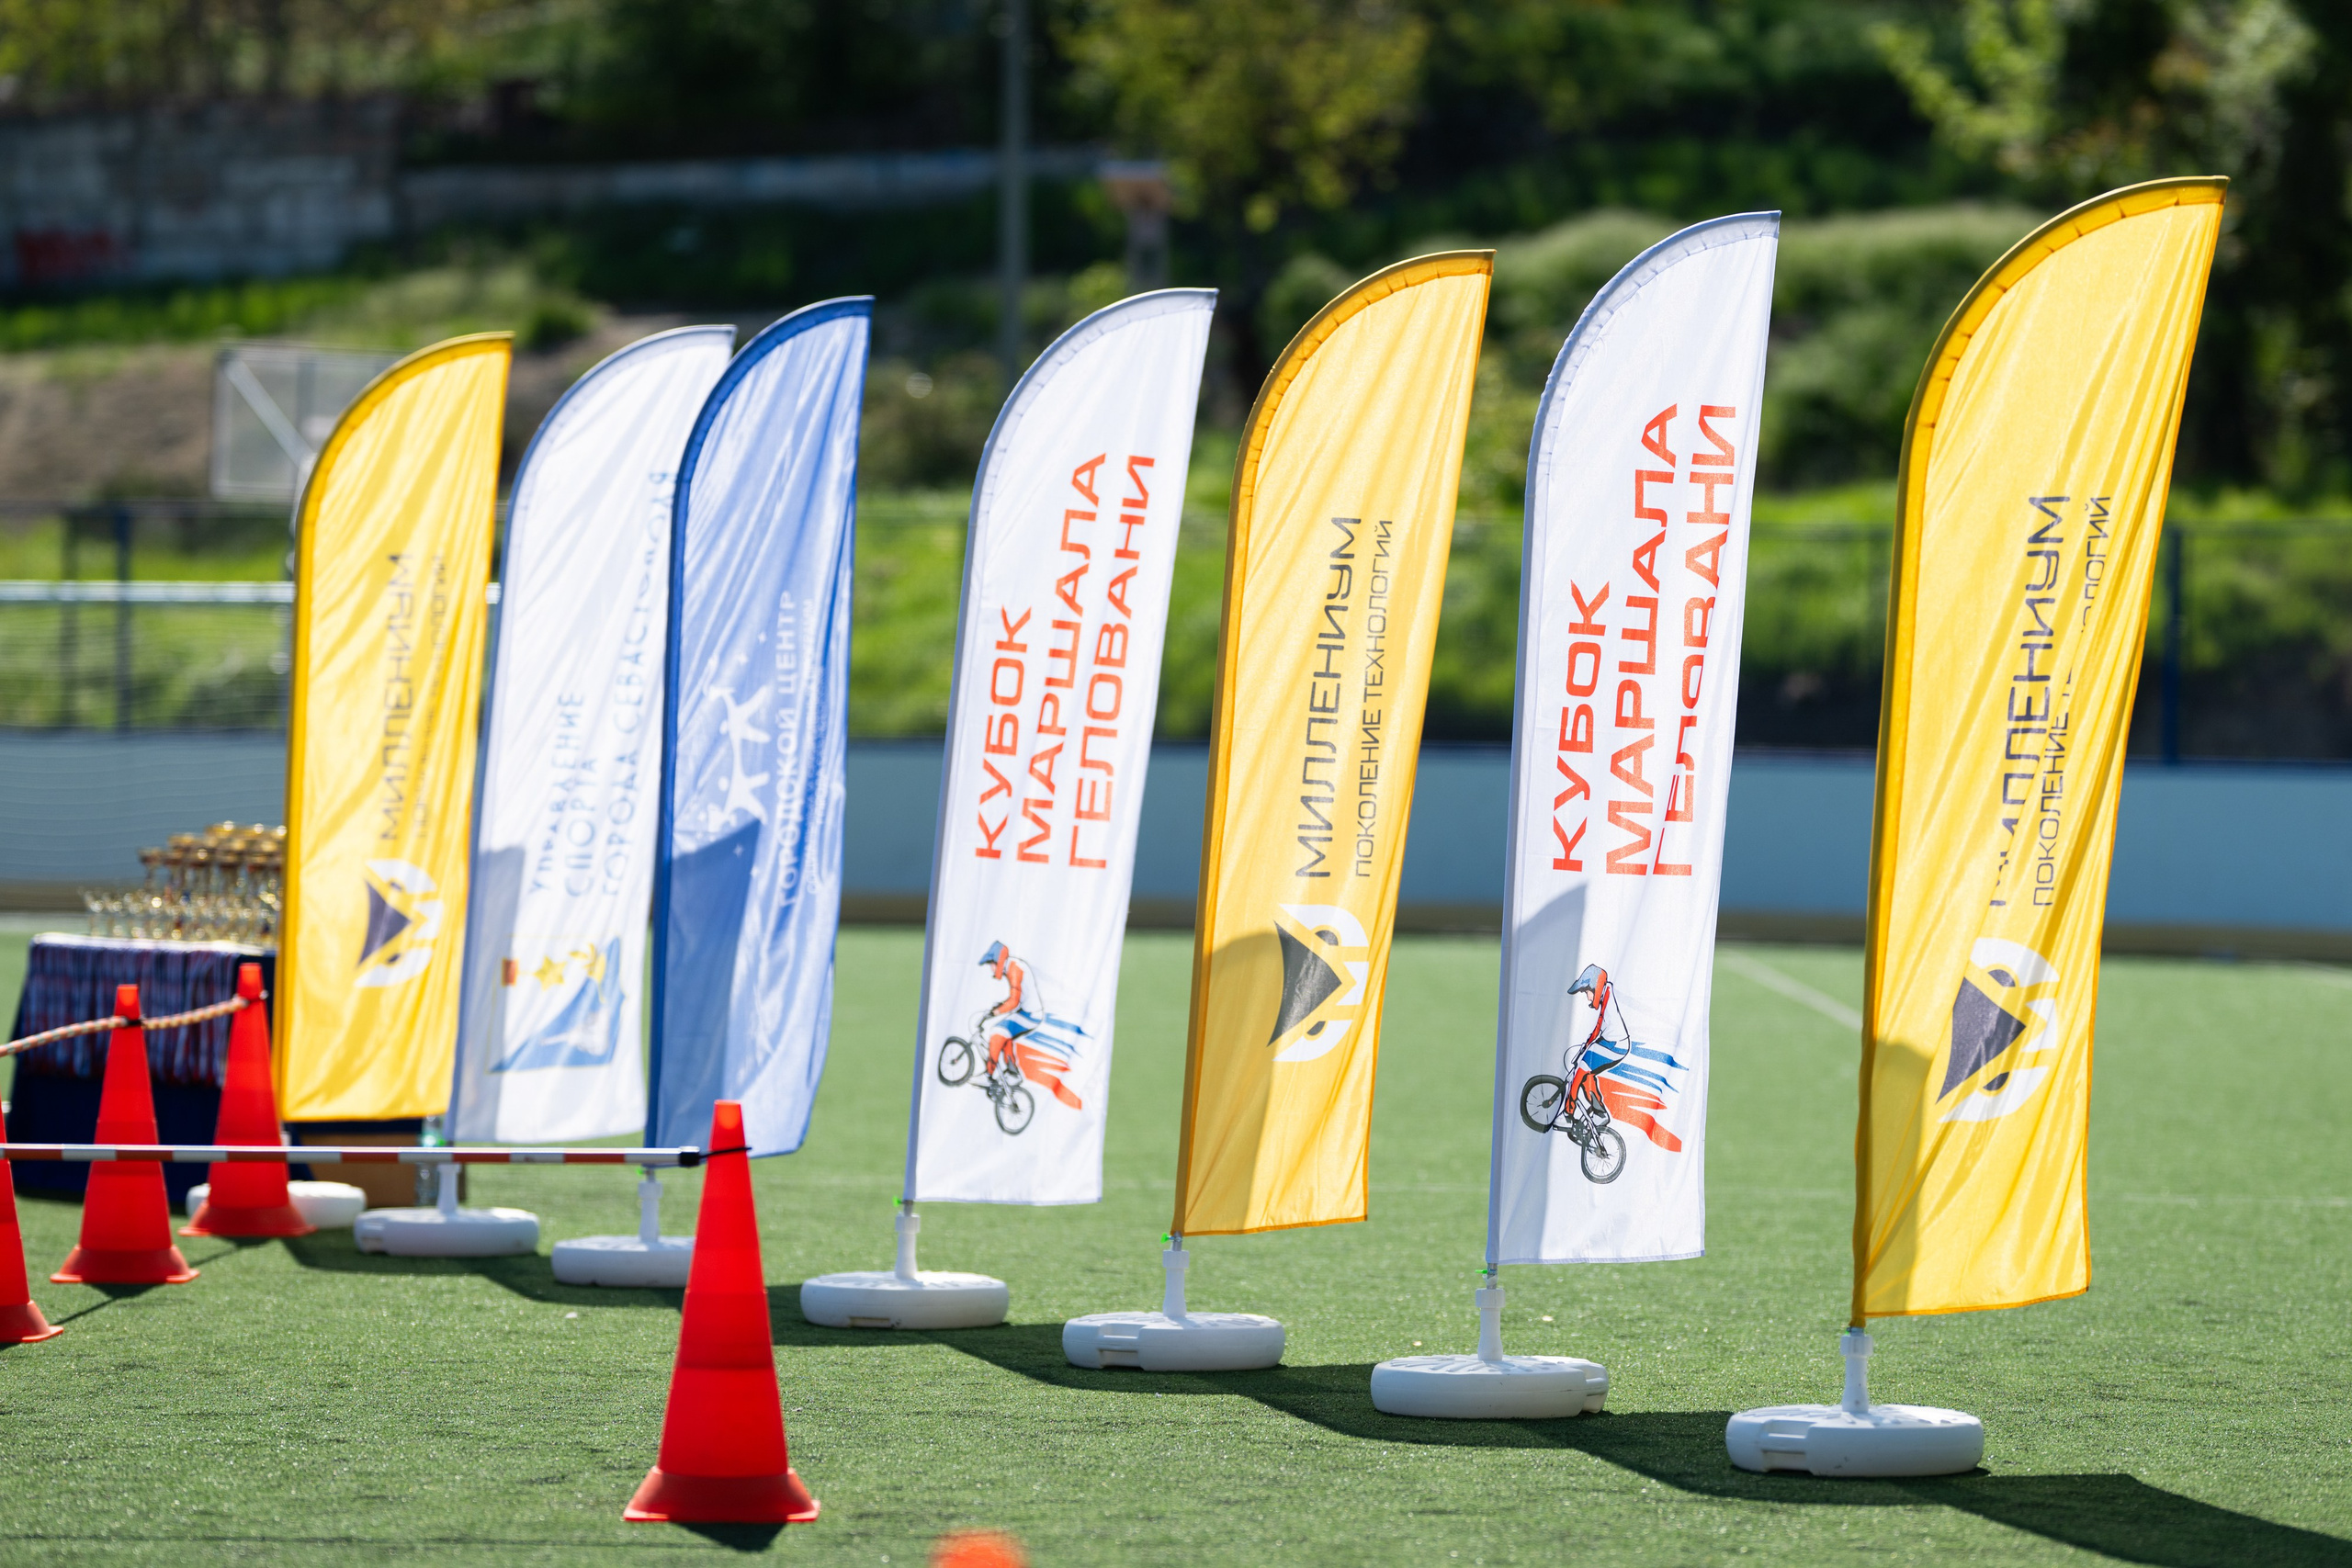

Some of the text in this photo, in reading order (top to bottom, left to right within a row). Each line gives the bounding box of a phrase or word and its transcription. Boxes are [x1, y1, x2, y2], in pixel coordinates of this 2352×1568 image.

[379, 554, 414, 840] МИЛЛЕНИУМ
[775, 590, 805, 908] ГОРОДСКОЙ ЦЕНТР
[975, 604, 1032, 859] КУБОК
[1016, 452, 1106, 863] МАРШАЛА
[1069, 455, 1155, 869] ГЕЛОВАНИ
[1295, 517, 1362, 877] МИЛЛЕНИУМ
[1355, 519, 1392, 877] ПОКОЛЕНИЕ ТЕХНОЛОГИЙ
[1553, 580, 1610, 872] КУБОК
[1606, 403, 1678, 876] МАРШАЛА
[528, 692, 584, 894] УПРАВЛЕНИЕ
[564, 758, 598, 897] СПОРТА
[603, 750, 639, 897] ГОРОДА
[2032, 712, 2069, 906] ПОКОЛЕНИЕ
